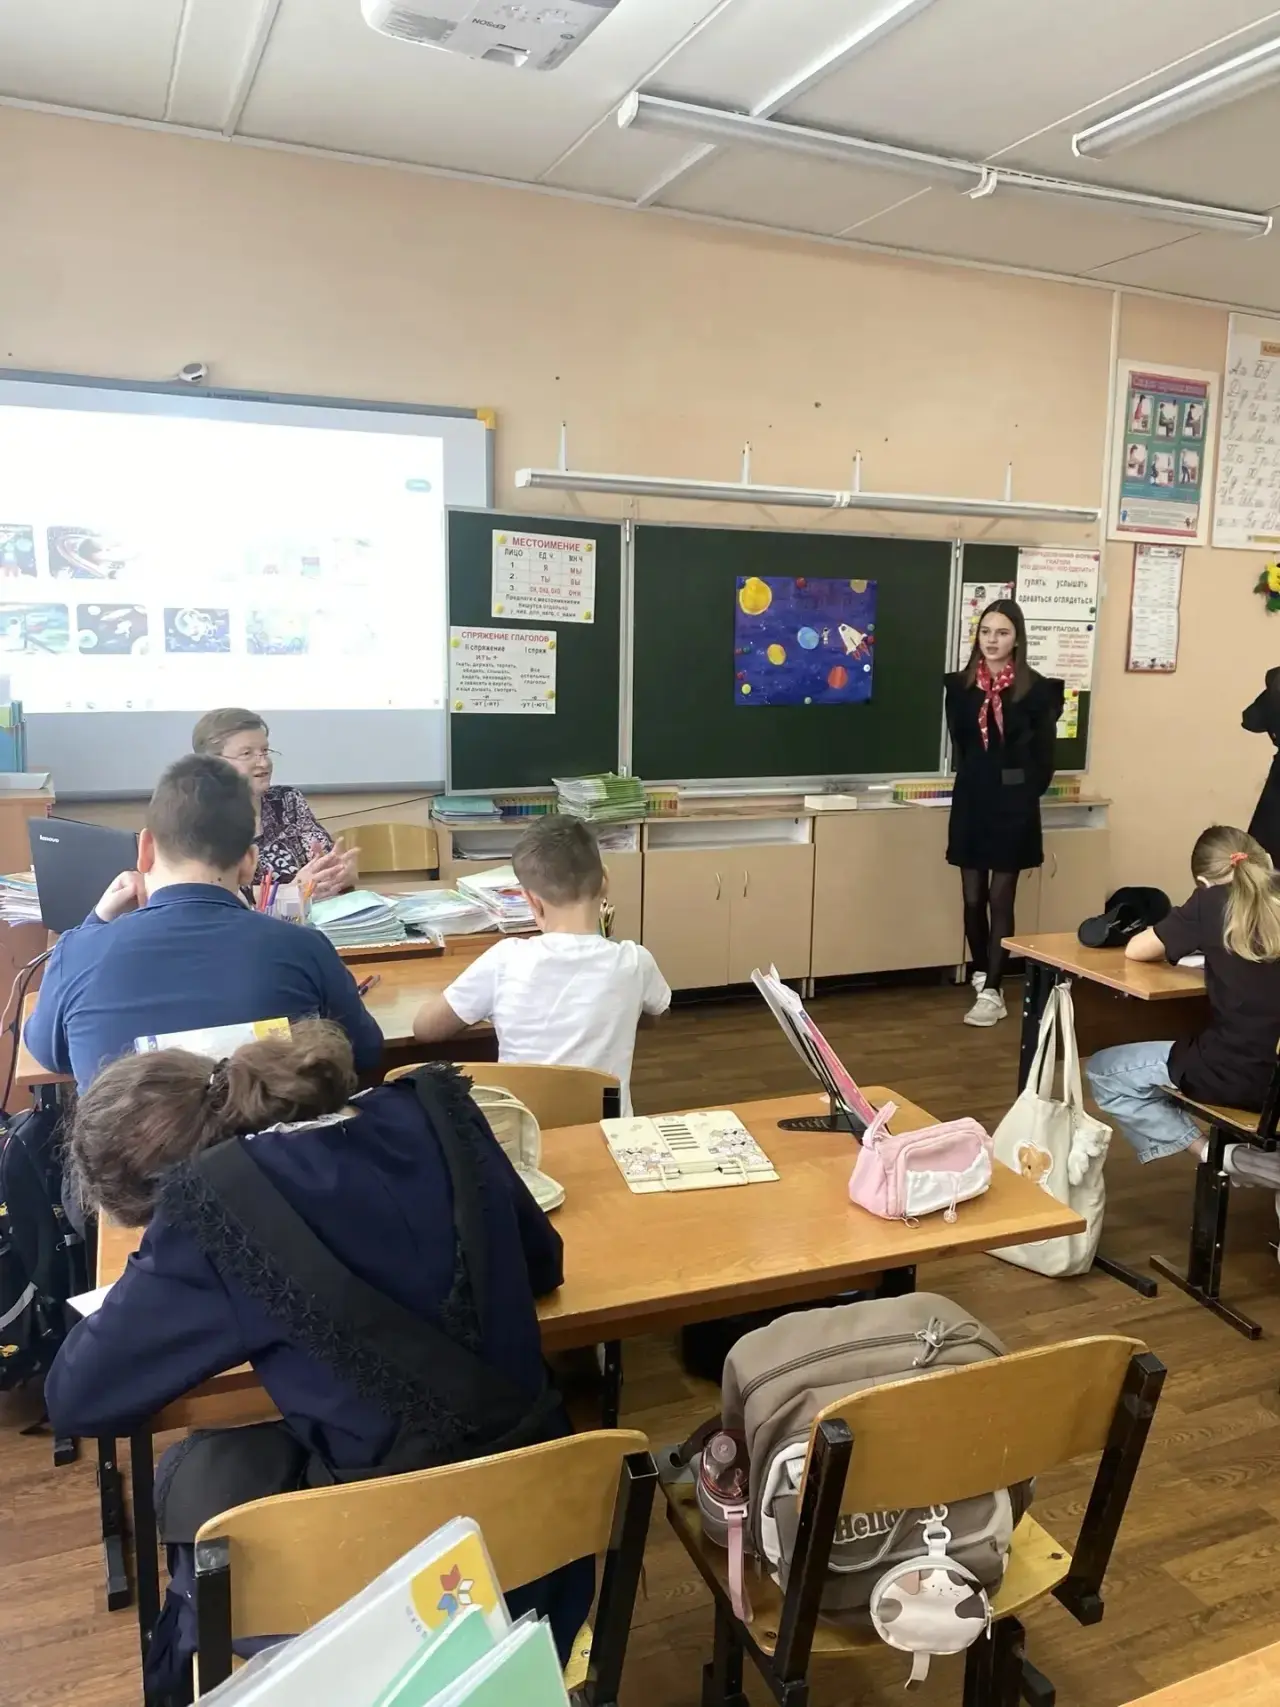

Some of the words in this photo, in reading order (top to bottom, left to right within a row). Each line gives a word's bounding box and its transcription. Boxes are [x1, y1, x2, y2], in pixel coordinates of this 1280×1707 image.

[472, 17, 507, 31] EPSON
[512, 537, 581, 552] МЕСТОИМЕНИЕ
[504, 548, 524, 558] ЛИЦО
[540, 575, 551, 583] ТЫ
[1024, 578, 1047, 588] гулять
[1056, 579, 1088, 589] услышать
[1018, 594, 1052, 604] одеваться
[1053, 595, 1094, 605] оглядеться
[1030, 624, 1051, 632] ВРЕМЯ
[1052, 625, 1081, 633] ГЛАГОЛА
[461, 631, 509, 641] СПРЯЖЕНИЕ
[510, 634, 550, 643] ГЛАГОЛОВ
[470, 645, 506, 653] спряжение
[39, 834, 60, 844] lenovo
